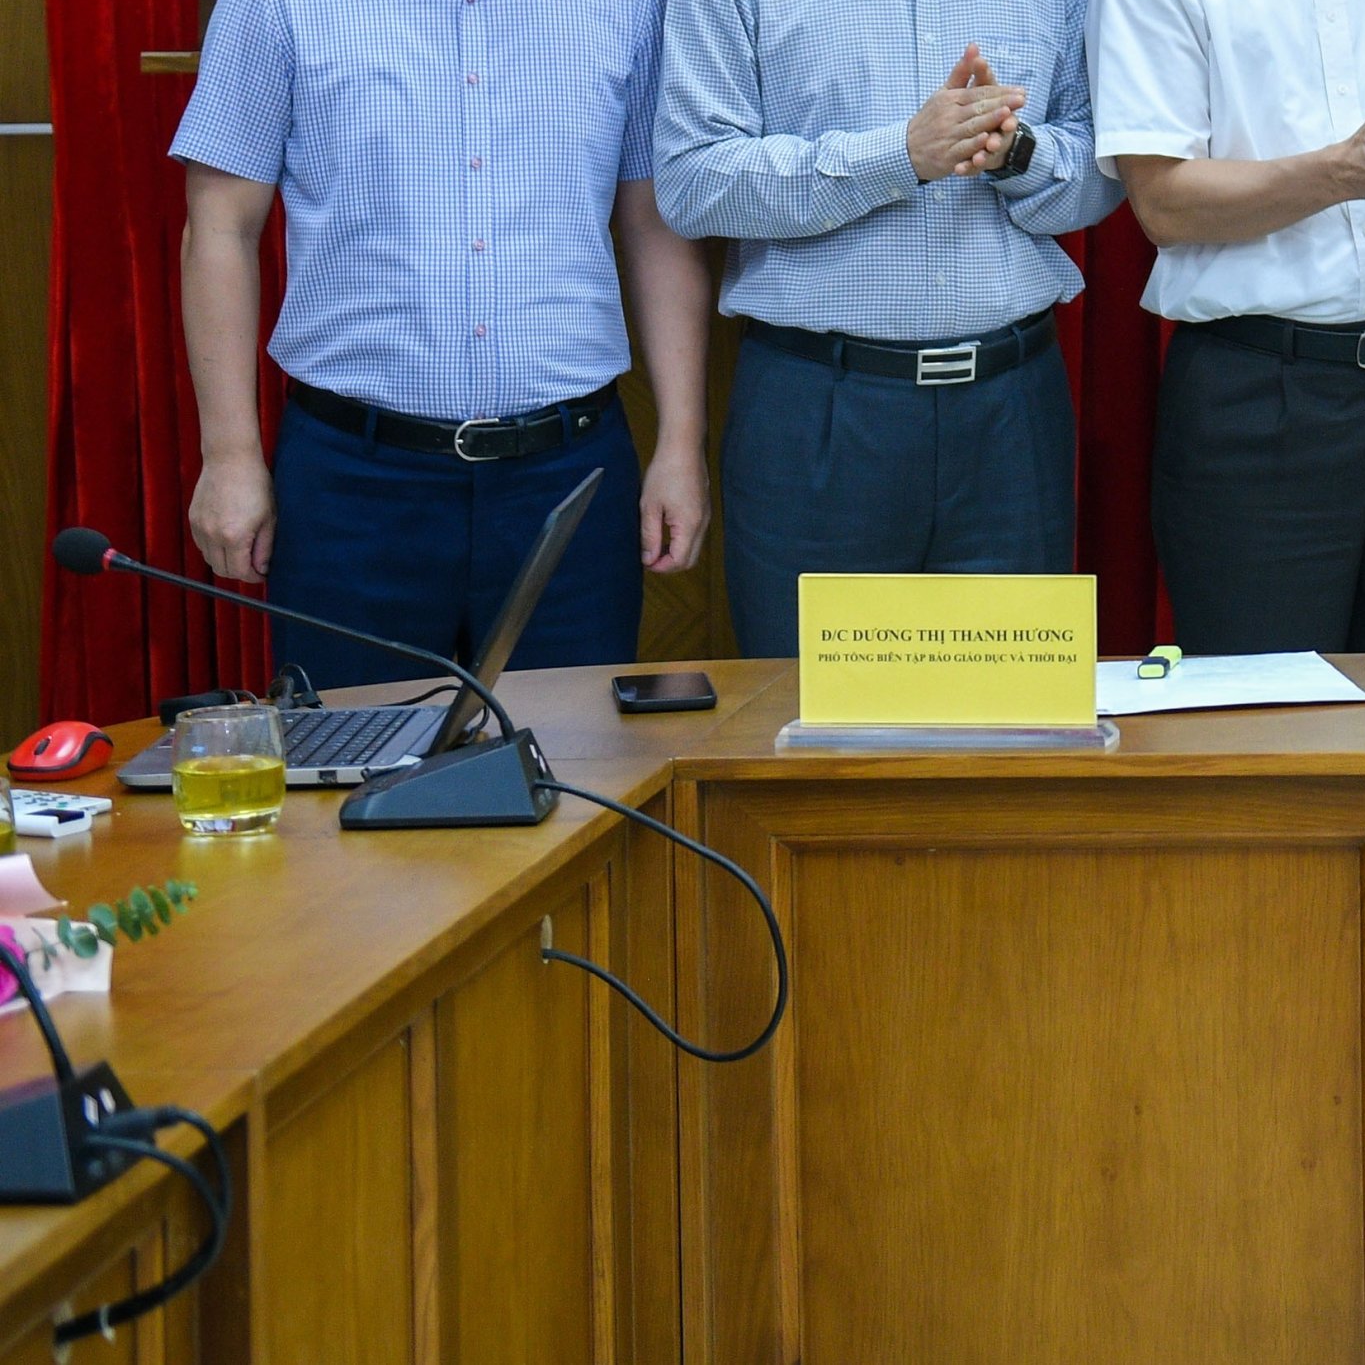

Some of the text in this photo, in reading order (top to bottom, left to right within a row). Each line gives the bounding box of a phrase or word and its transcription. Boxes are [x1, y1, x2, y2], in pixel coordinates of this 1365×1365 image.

[821, 627, 1074, 644] Đ/C DƯƠNG THỊ THANH HƯƠNG
[818, 651, 841, 662] PHÓ
[877, 651, 902, 662] BIÊN
[928, 651, 951, 662] BÁO
[954, 651, 982, 663] GIÁO
[984, 653, 1007, 664] DỤC
[1010, 651, 1025, 662] VÀ
